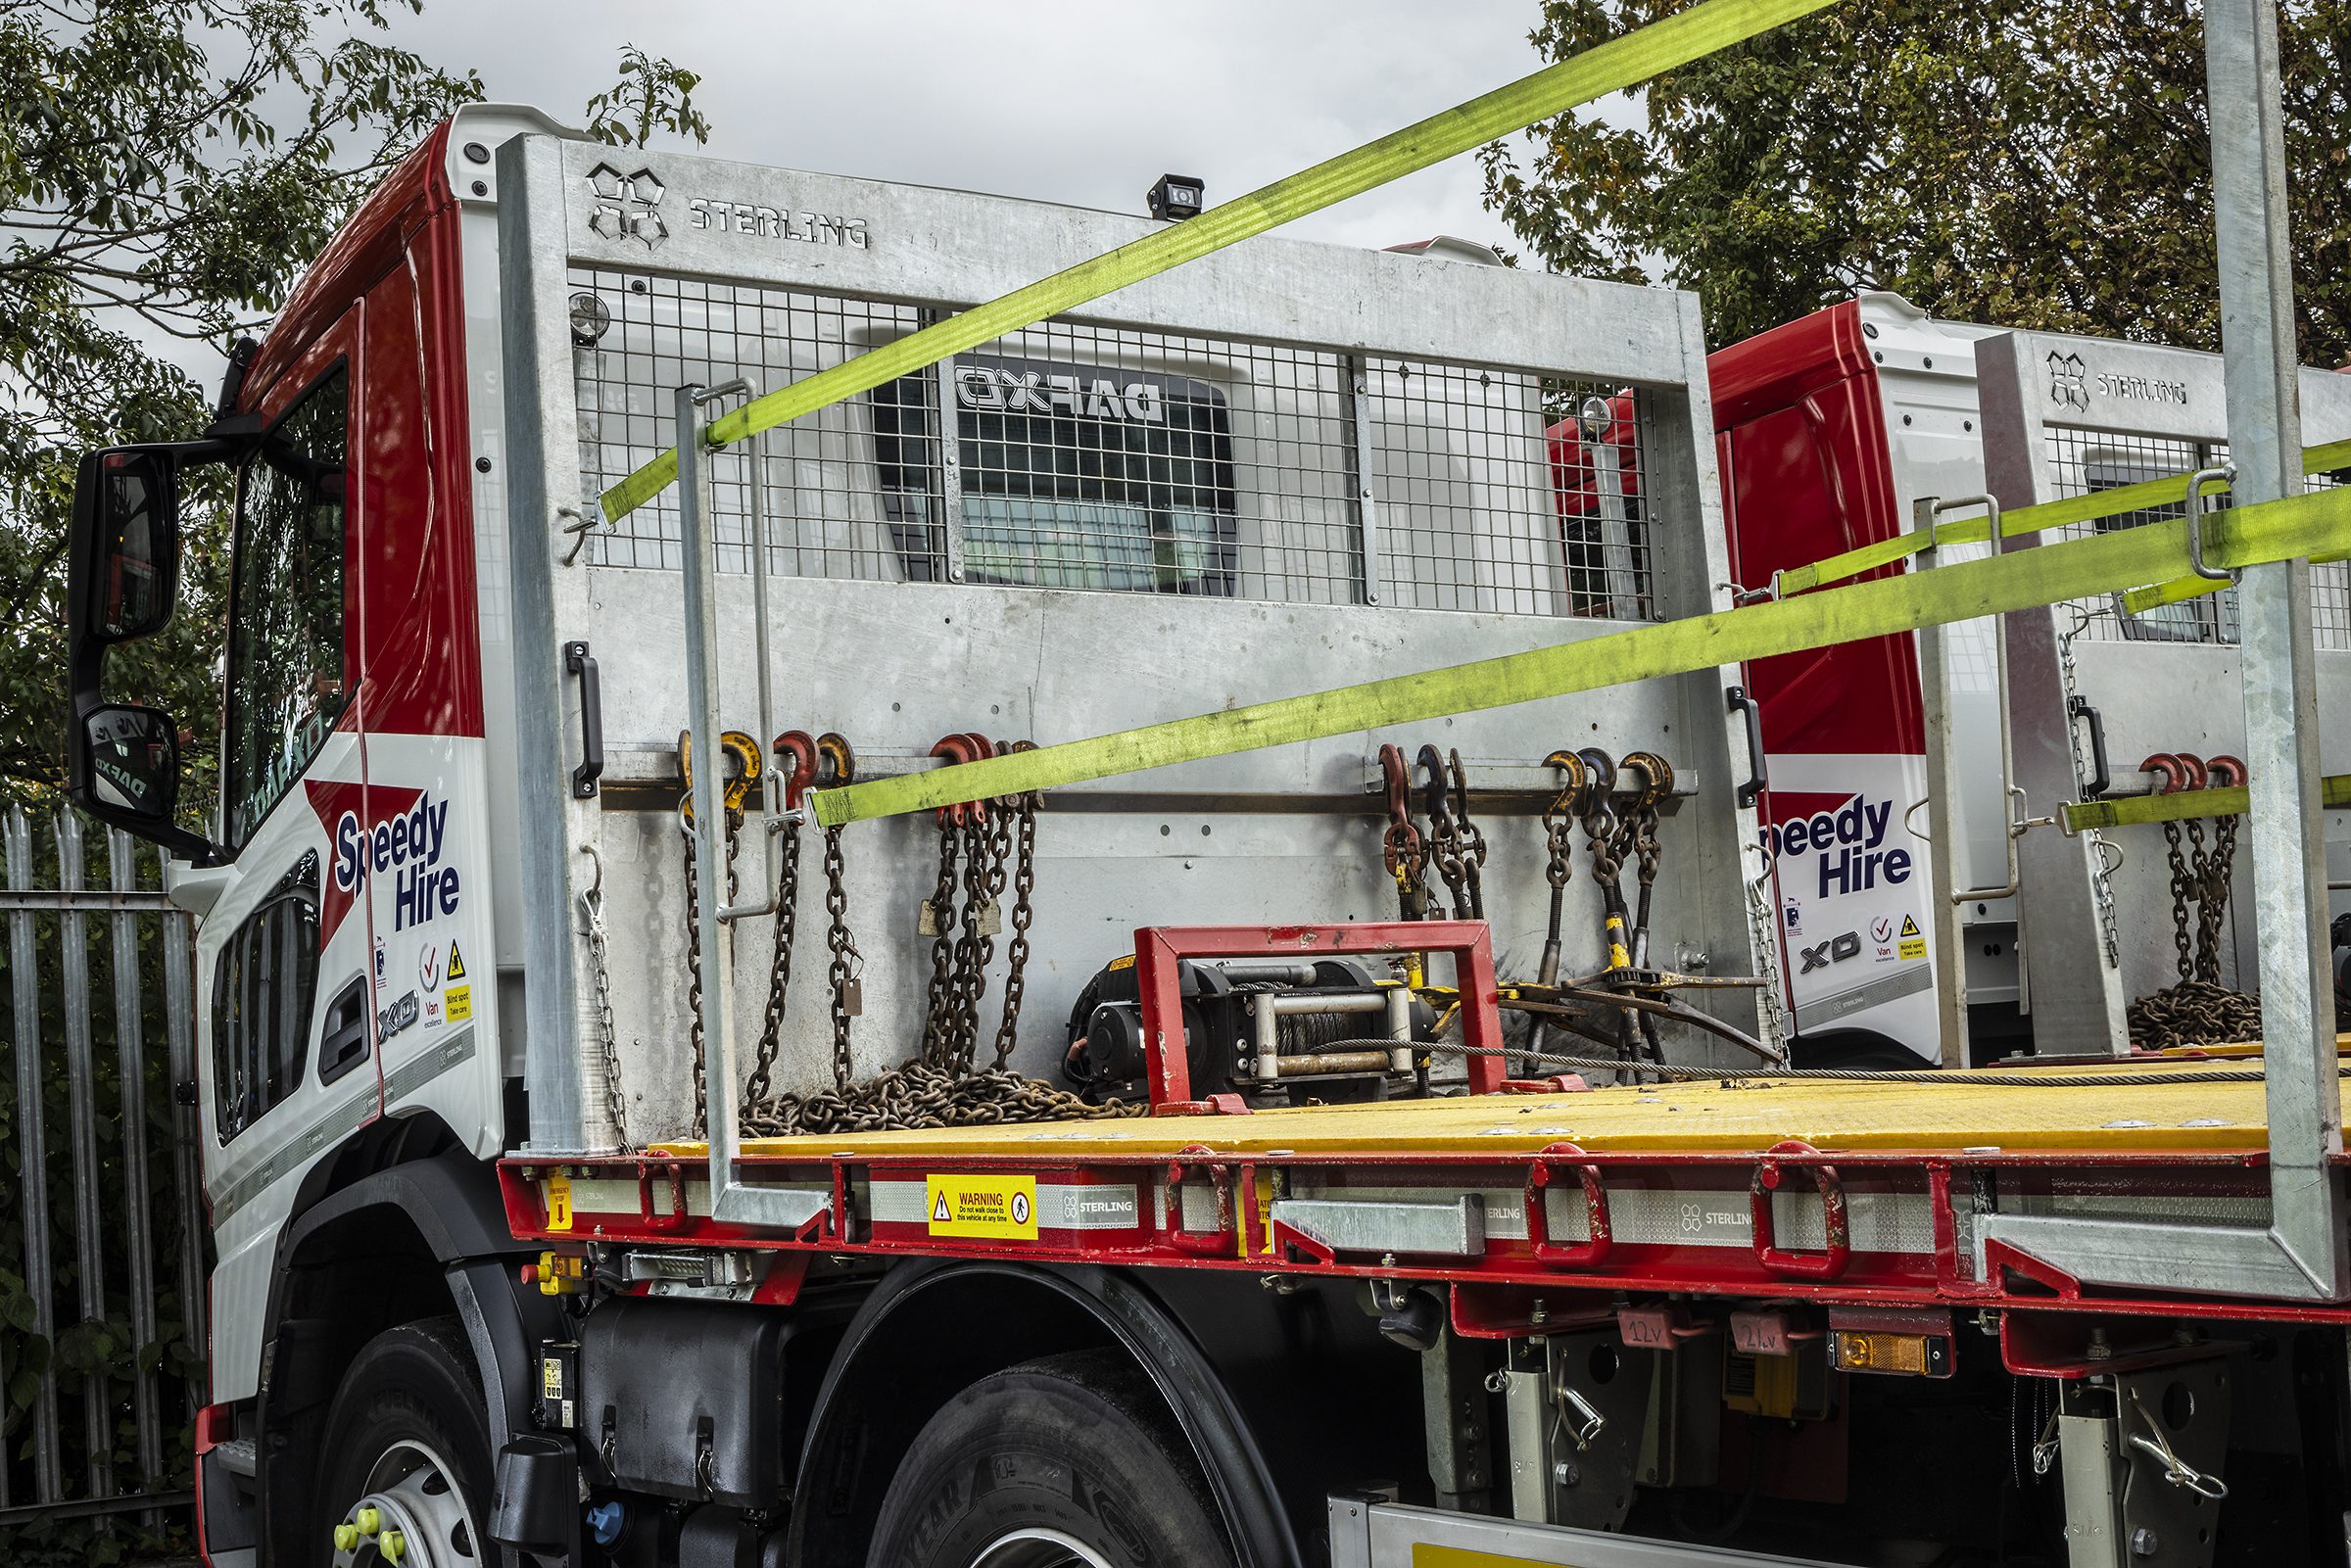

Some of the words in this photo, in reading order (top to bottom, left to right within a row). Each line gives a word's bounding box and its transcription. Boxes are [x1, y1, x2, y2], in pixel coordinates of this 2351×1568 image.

[690, 197, 869, 250] STERLING
[2097, 372, 2187, 404] STERLING
[1759, 792, 1894, 868] peedy
[336, 789, 449, 899] Speedy
[1818, 844, 1912, 899] Hire
[395, 866, 460, 932] Hire
[1799, 929, 1861, 974] XD
[1876, 947, 1892, 956] Van
[447, 994, 458, 1004] Blind
[457, 993, 469, 1003] spot
[425, 1001, 439, 1016] Van
[377, 988, 420, 1045] XD
[424, 1018, 443, 1029] excellence
[555, 1194, 565, 1203] STOP
[959, 1192, 1004, 1206] WARNING
[1080, 1201, 1132, 1212] STERLING
[1485, 1207, 1520, 1219] TERLING
[1705, 1212, 1752, 1224] STERLIN
